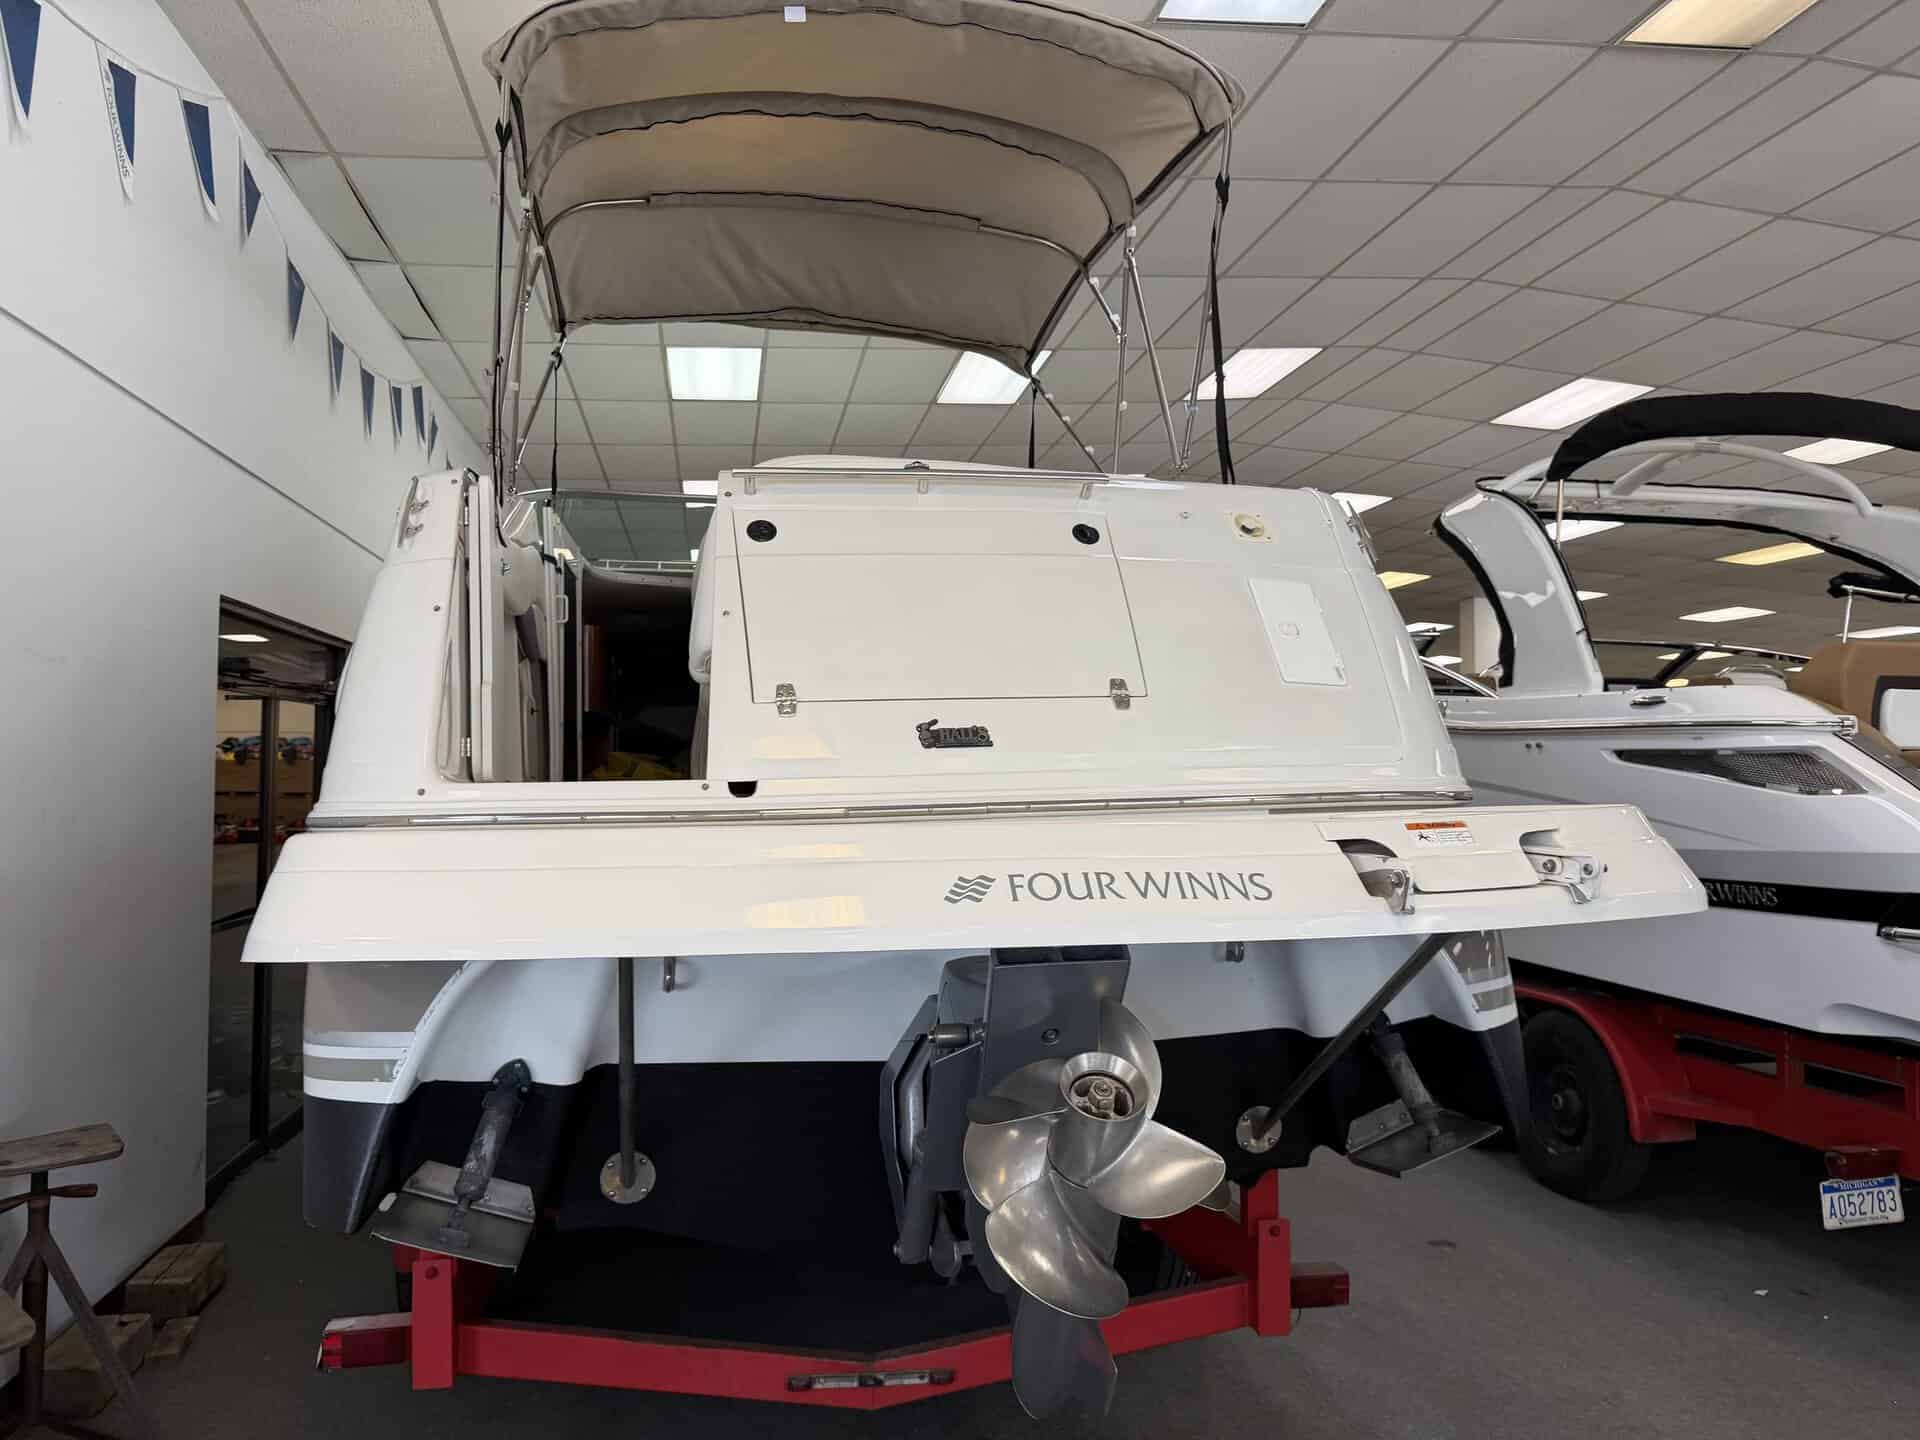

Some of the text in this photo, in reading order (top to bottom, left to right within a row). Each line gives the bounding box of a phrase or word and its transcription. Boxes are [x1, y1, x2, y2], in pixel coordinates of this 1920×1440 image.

[1008, 871, 1273, 901] FOUR WINNS
[1715, 883, 1779, 906] WINNS
[1829, 1189, 1897, 1219] A052783
